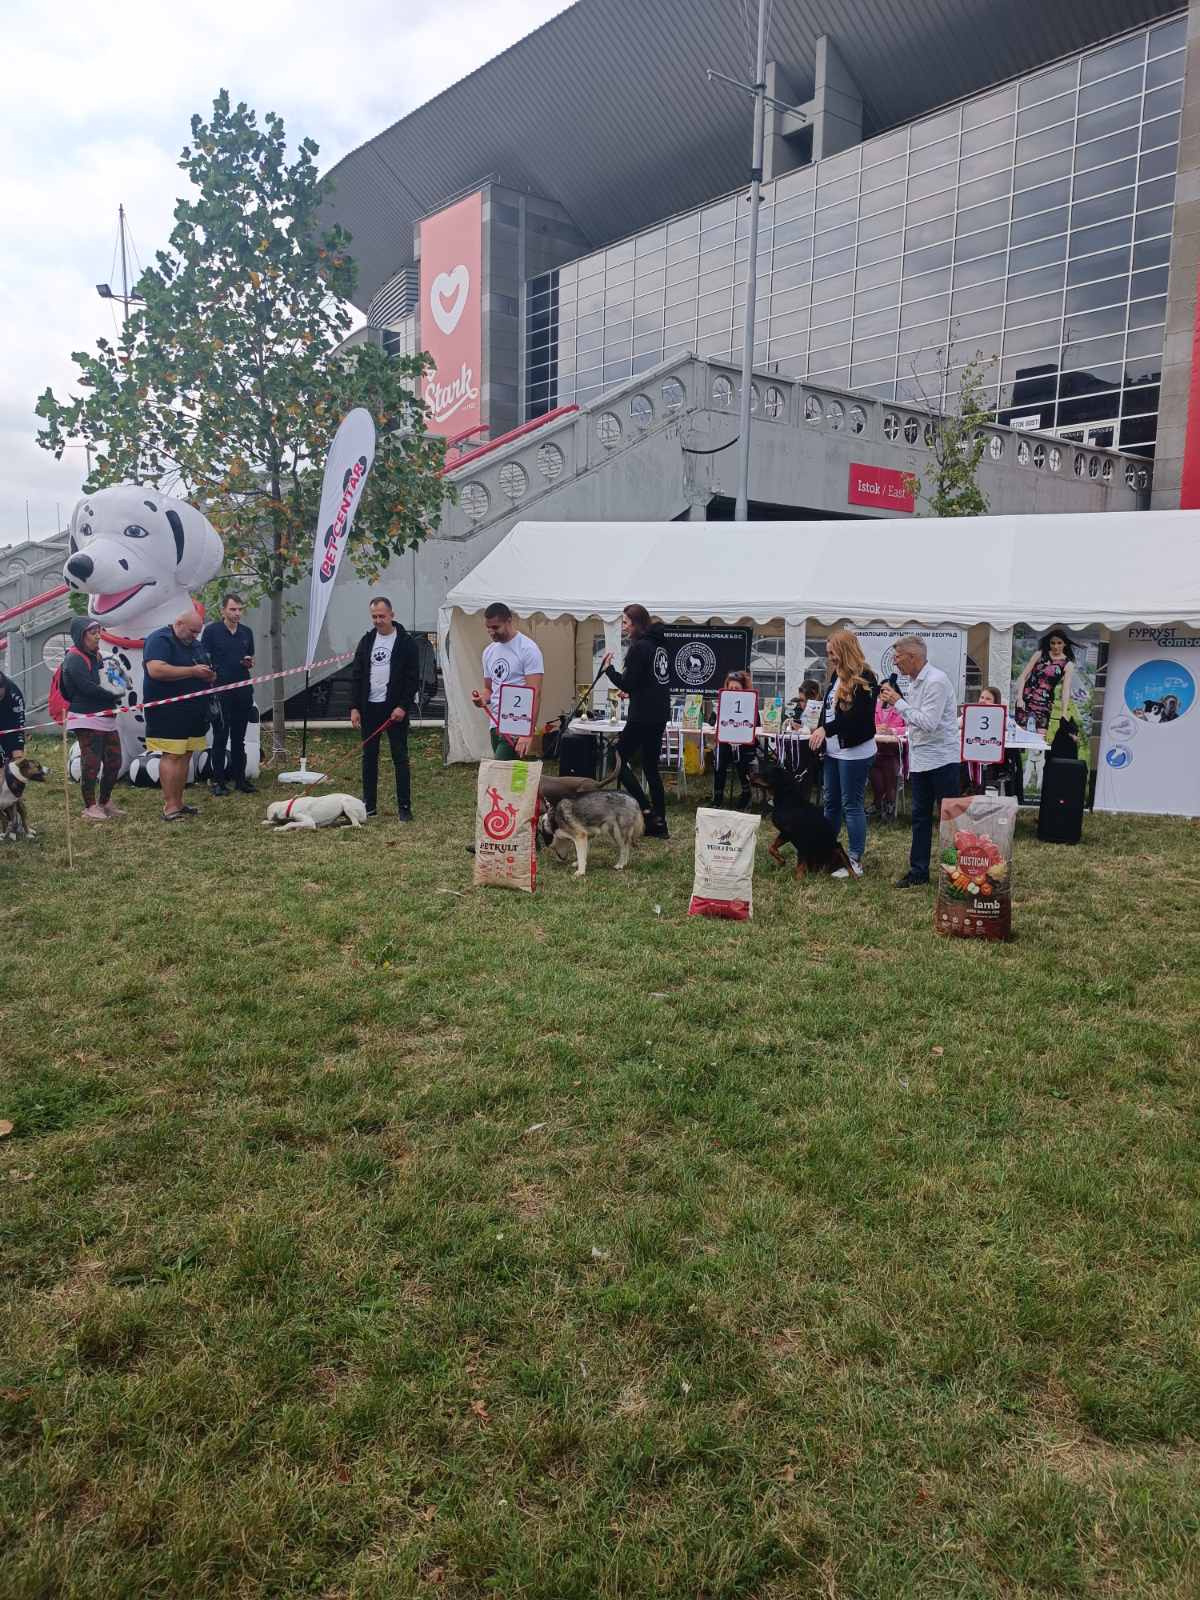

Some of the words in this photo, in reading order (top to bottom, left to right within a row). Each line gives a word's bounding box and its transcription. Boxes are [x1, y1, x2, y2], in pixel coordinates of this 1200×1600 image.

[858, 480, 880, 495] Istok
[321, 536, 338, 577] PET
[333, 462, 364, 538] CENTAR
[1129, 628, 1176, 642] FYPRYST
[513, 695, 521, 708] 2
[734, 700, 743, 714] 1
[980, 716, 990, 730] 3
[480, 842, 520, 854] PETKULT
[960, 855, 990, 867] RUSTICAN
[974, 899, 1000, 909] lamb
